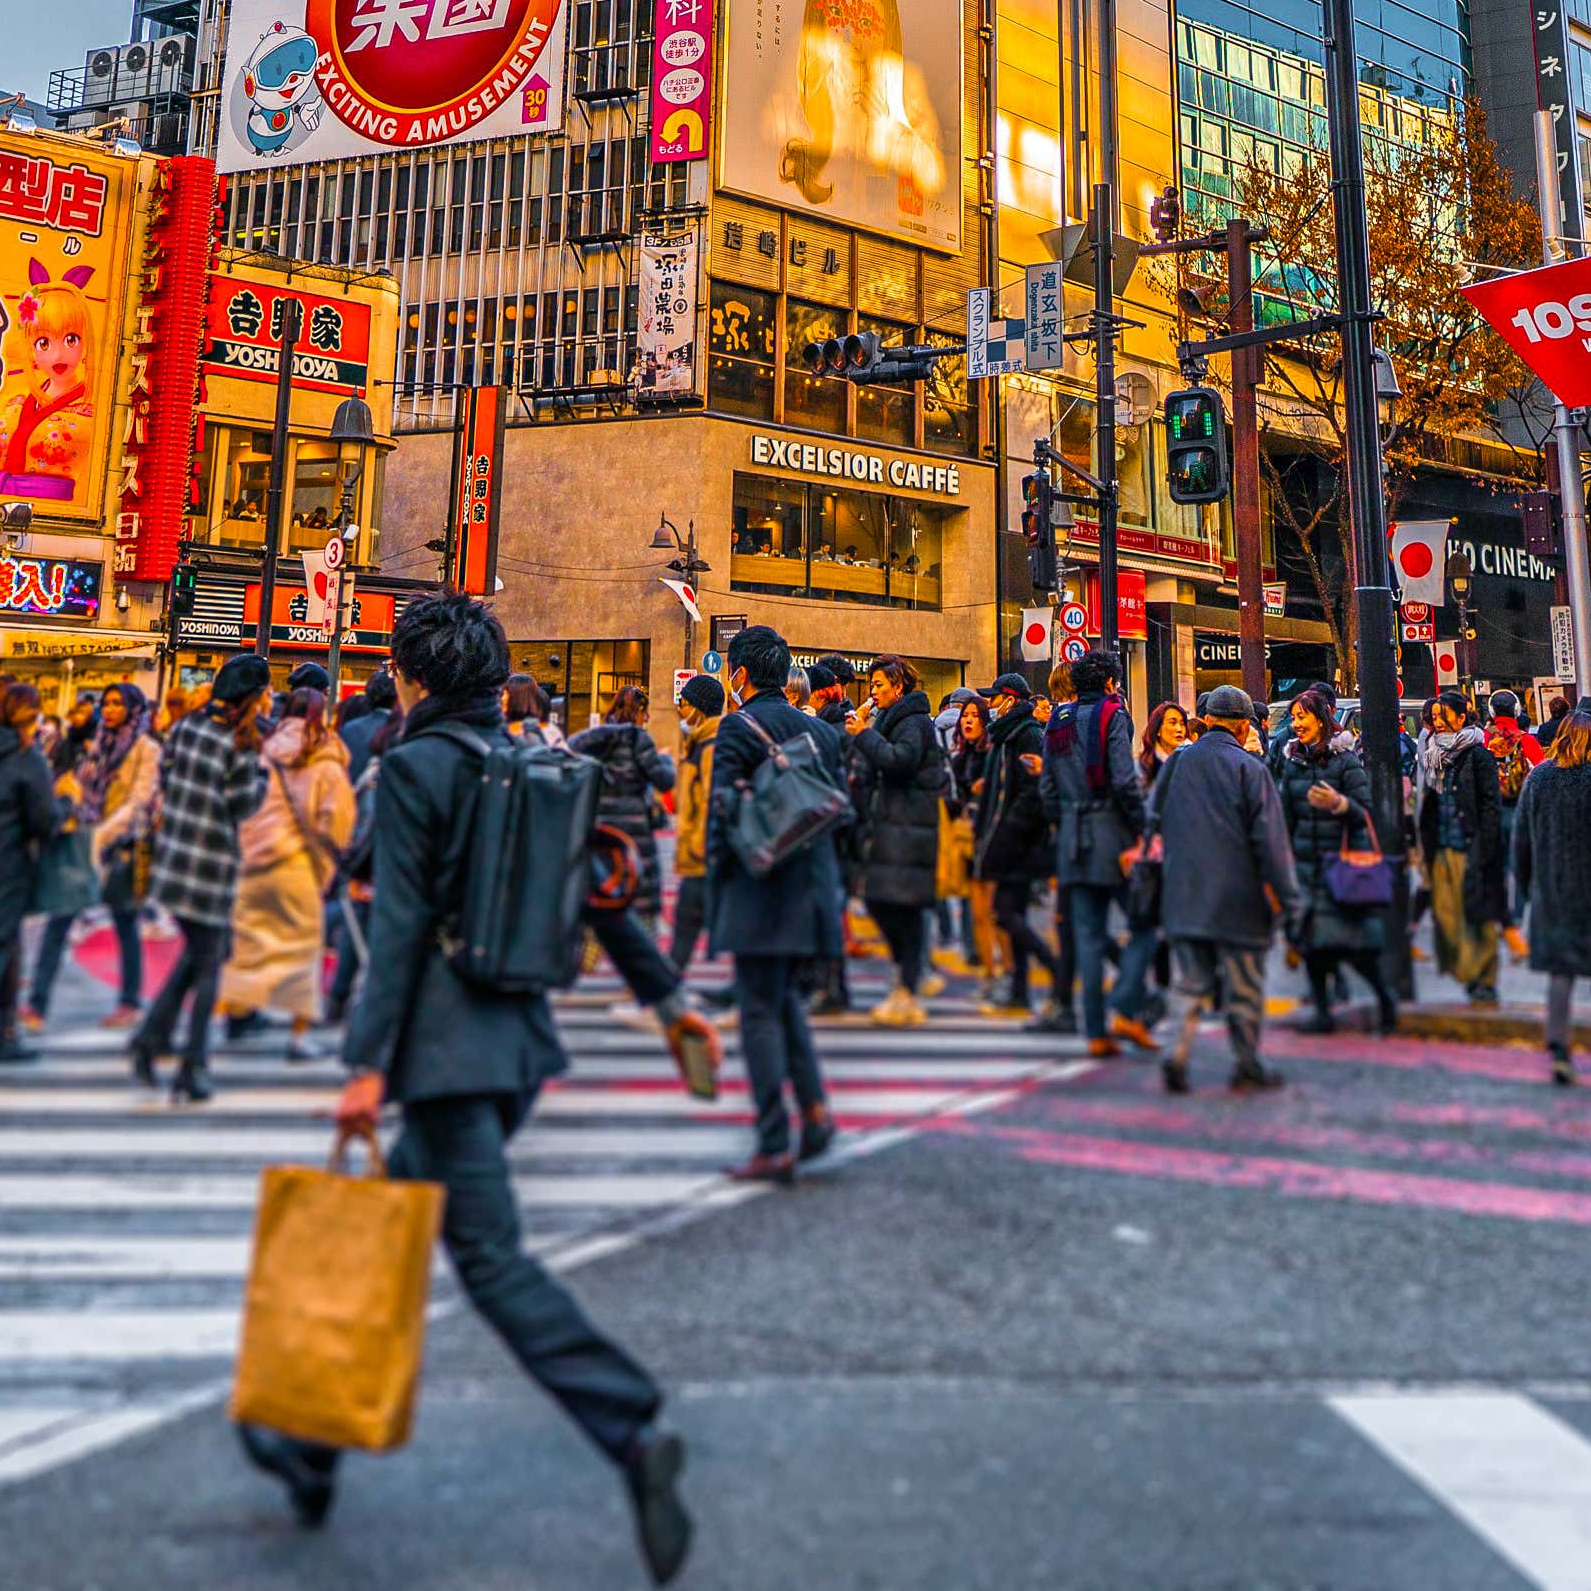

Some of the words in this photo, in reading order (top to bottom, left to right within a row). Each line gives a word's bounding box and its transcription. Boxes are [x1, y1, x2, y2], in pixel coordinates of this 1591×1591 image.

[668, 38, 697, 48] 渋谷駅
[666, 49, 699, 59] 徒歩1分
[315, 51, 398, 142] EXCITING
[406, 16, 550, 142] AMUSEMENT
[525, 90, 546, 106] 30
[658, 144, 683, 154] もどる
[725, 221, 840, 275] 岩崎ビル
[1041, 271, 1058, 361] 道玄坂下
[972, 292, 984, 374] スクランブル式
[990, 359, 1023, 374] 時差式
[752, 435, 883, 483] EXCELSIOR
[888, 459, 960, 495] CAFFÉ
[463, 455, 473, 524] YOSHINOYA
[473, 456, 489, 522] 吉野家
[329, 542, 339, 560] 3
[1067, 612, 1082, 624] 40
[180, 622, 240, 636] YOSHINOYA
